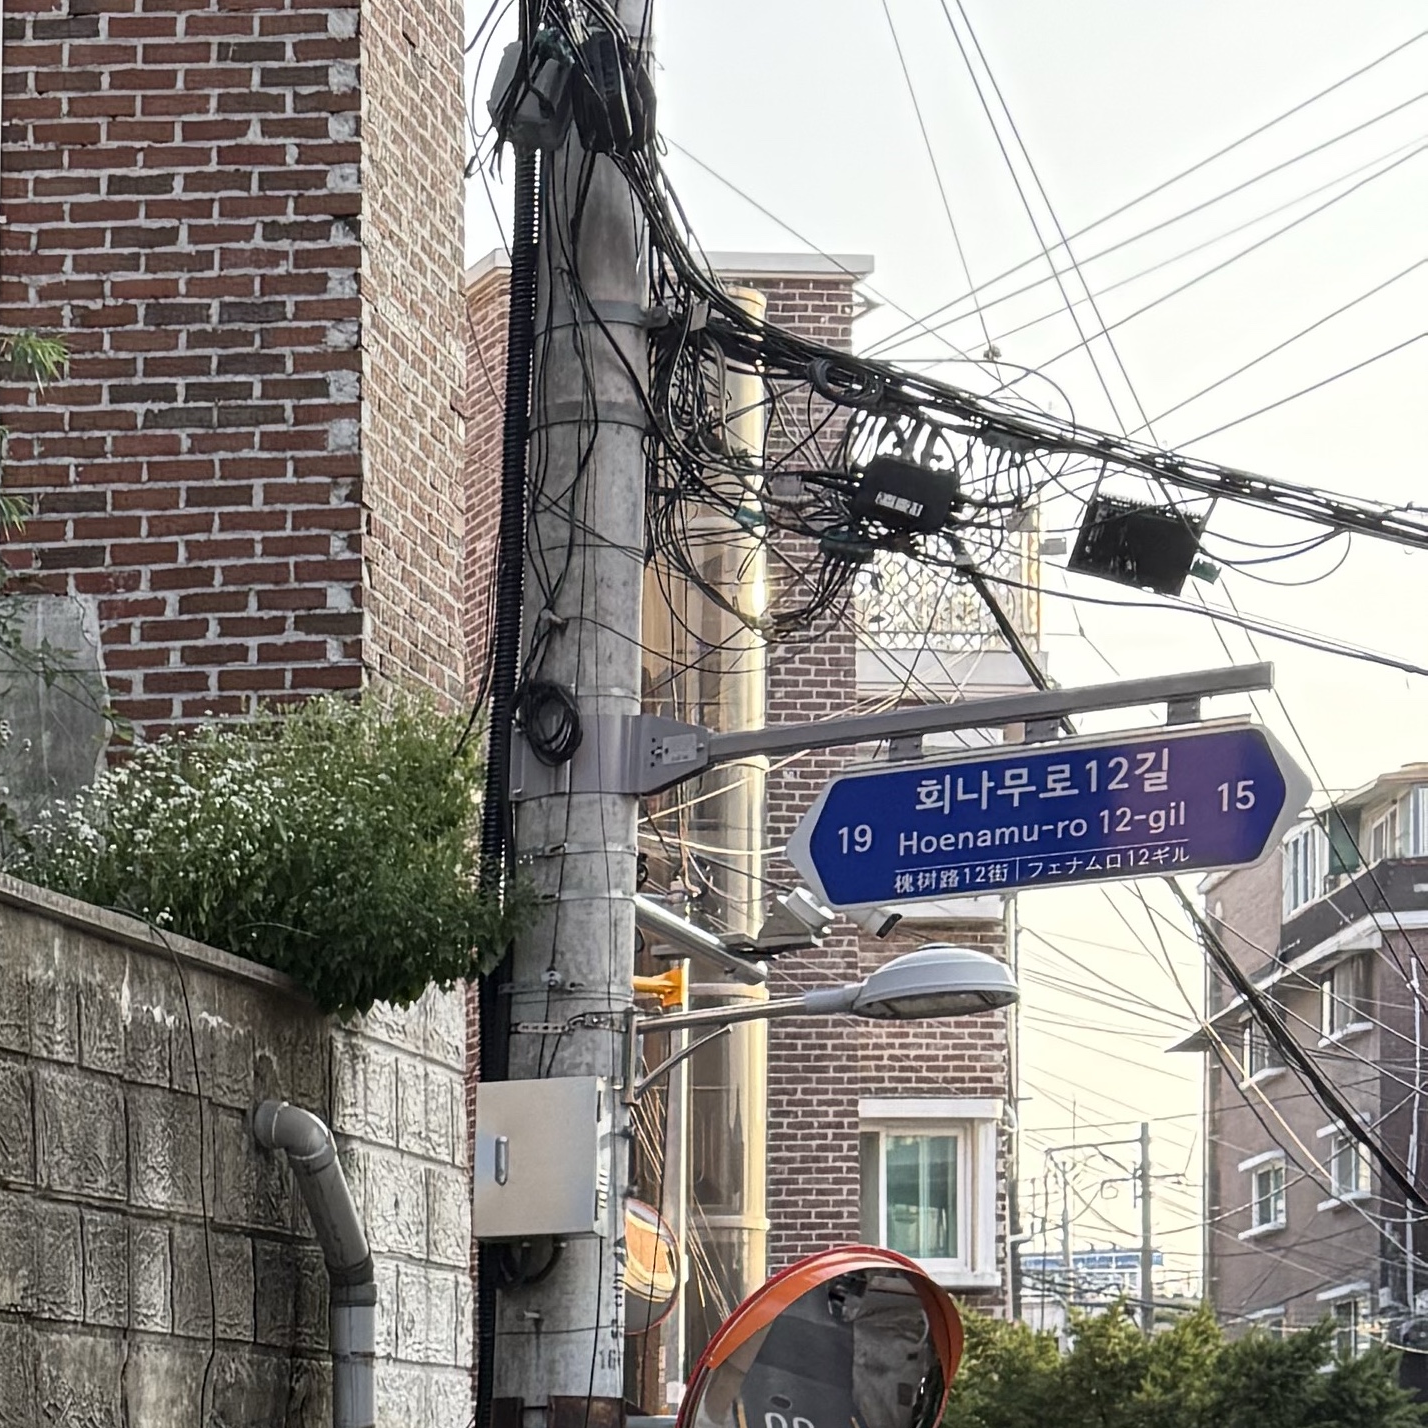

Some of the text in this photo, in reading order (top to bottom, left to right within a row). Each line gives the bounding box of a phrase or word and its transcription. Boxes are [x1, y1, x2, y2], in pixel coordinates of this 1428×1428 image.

[915, 747, 1169, 815] 회나무로12길
[1217, 780, 1256, 812] 15
[837, 824, 873, 854] 19
[899, 800, 1186, 857] Hoenamu-ro 12-gil
